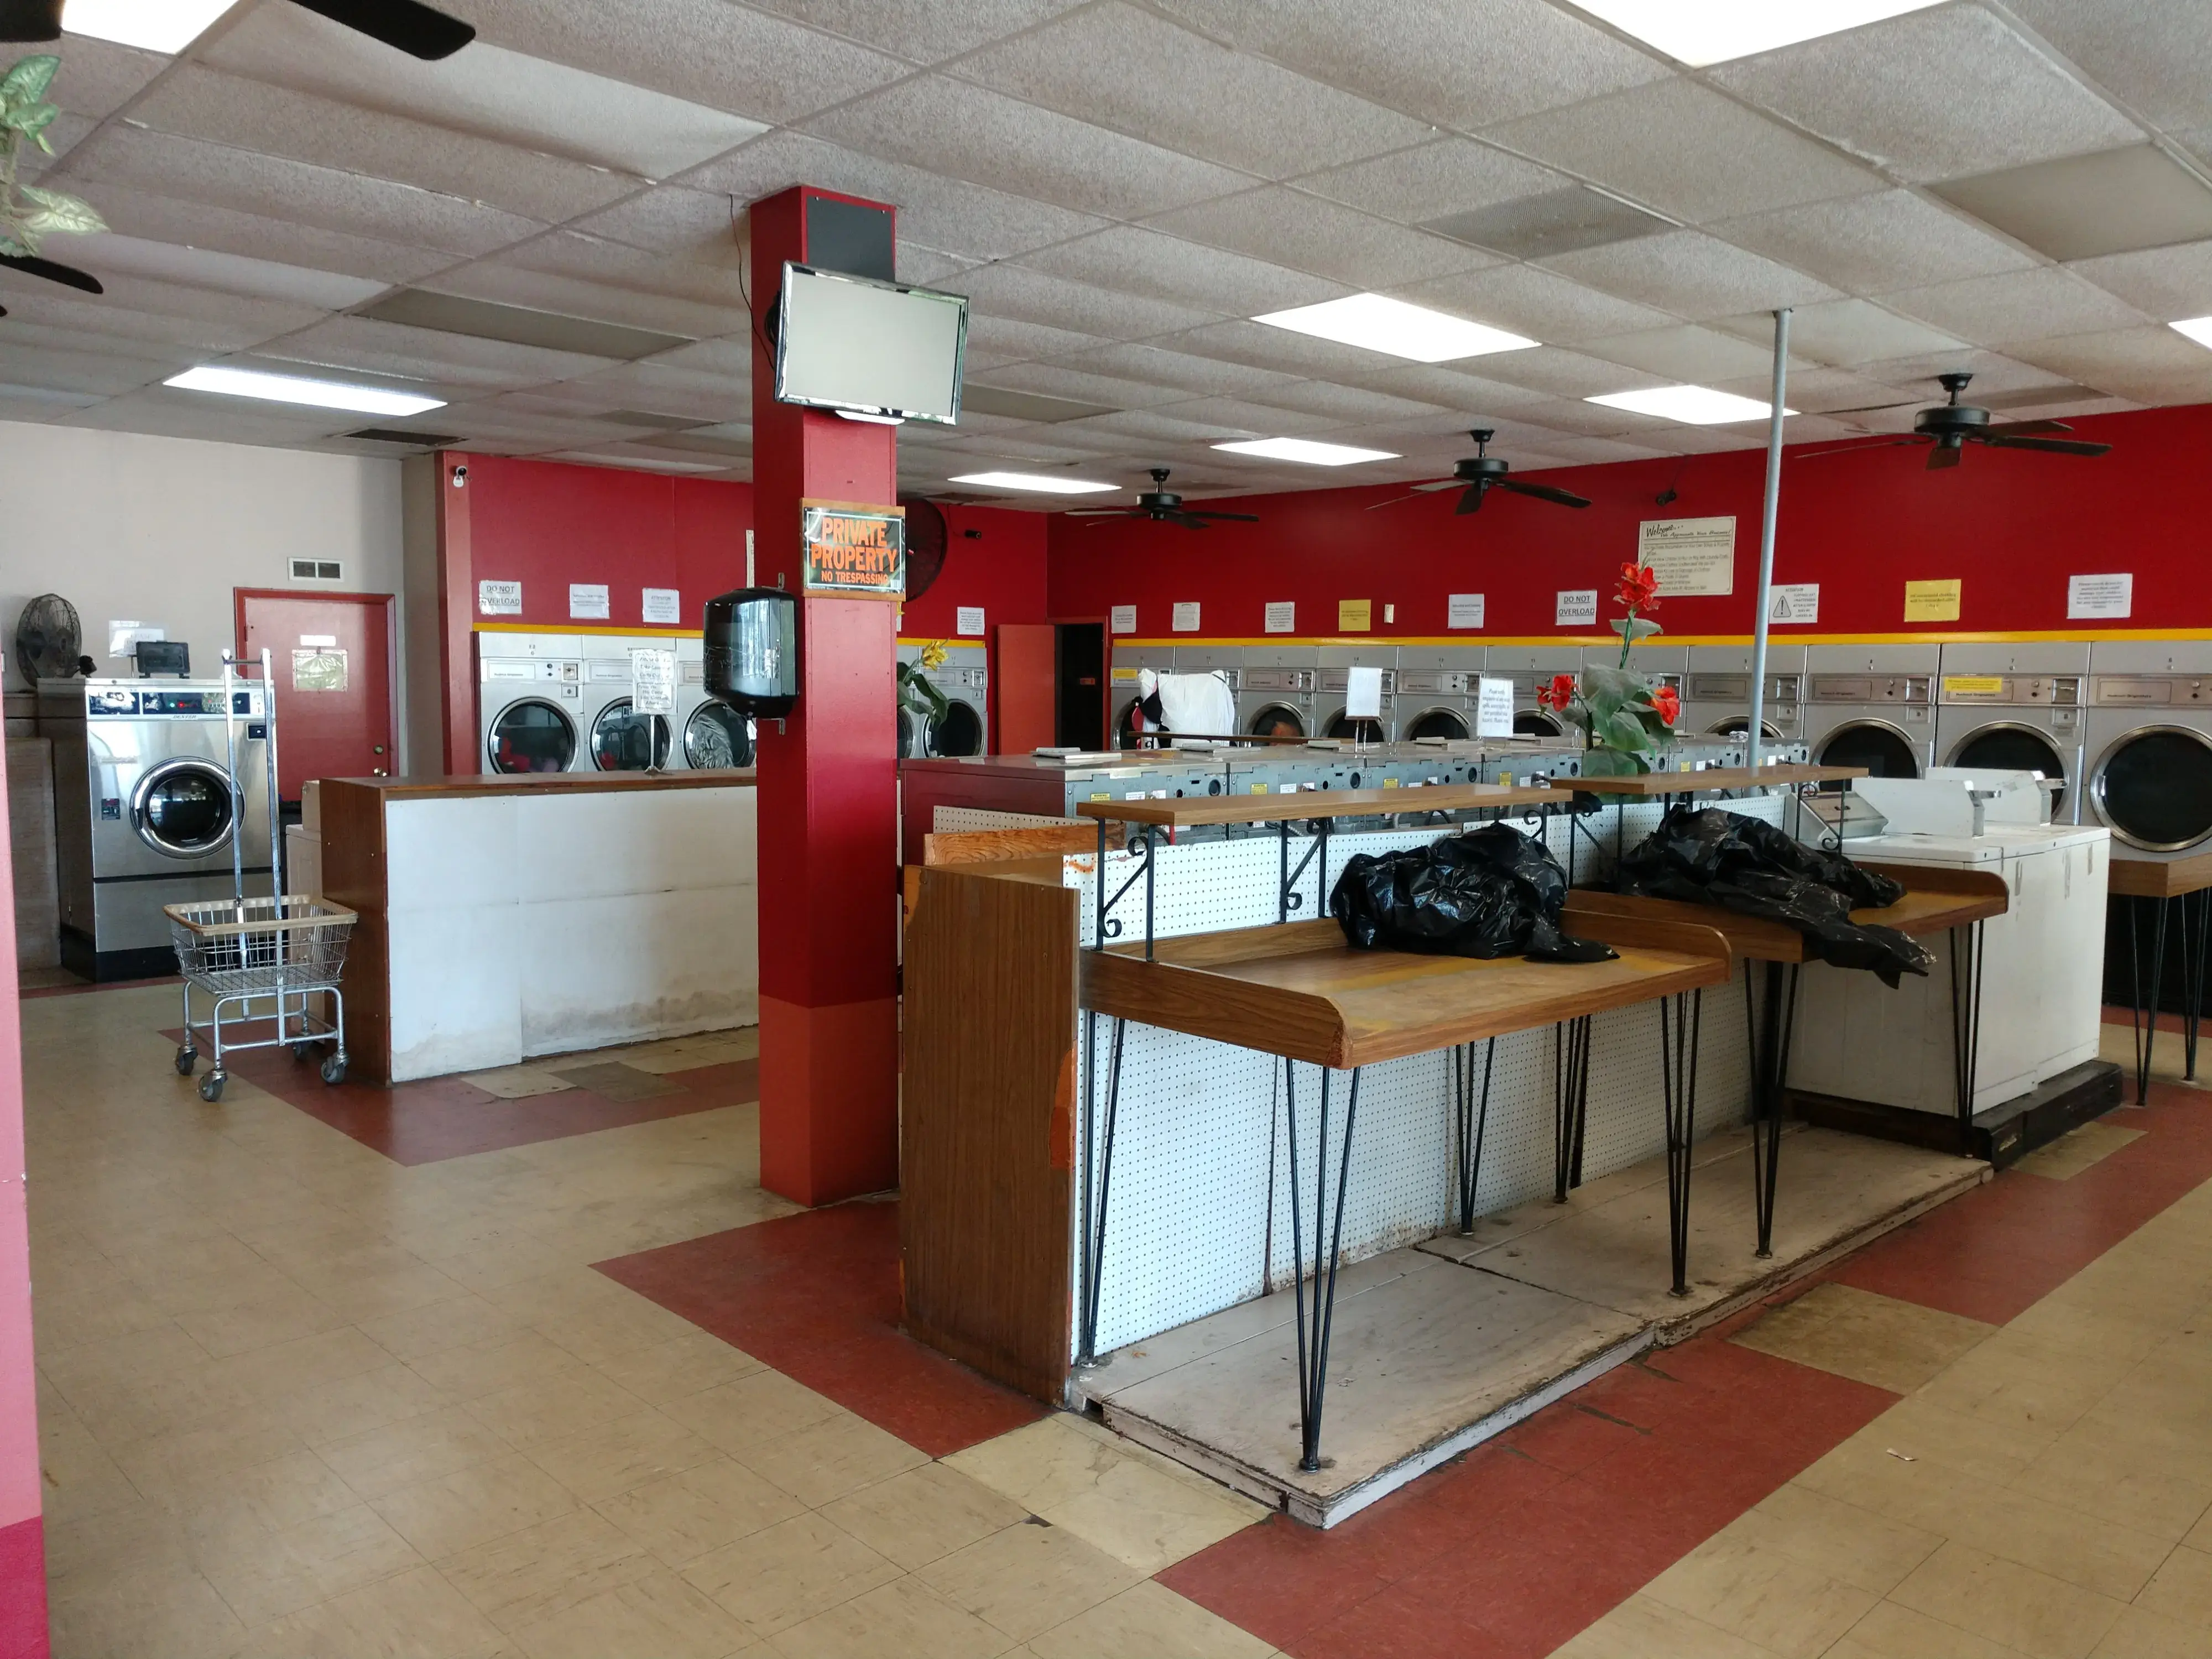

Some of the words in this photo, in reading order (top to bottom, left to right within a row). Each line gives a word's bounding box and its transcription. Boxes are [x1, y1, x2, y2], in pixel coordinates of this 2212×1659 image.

[822, 517, 888, 547] PRIVATE
[811, 543, 897, 572] PROPERTY
[821, 571, 833, 582] NO
[836, 571, 889, 585] TRESPASSING
